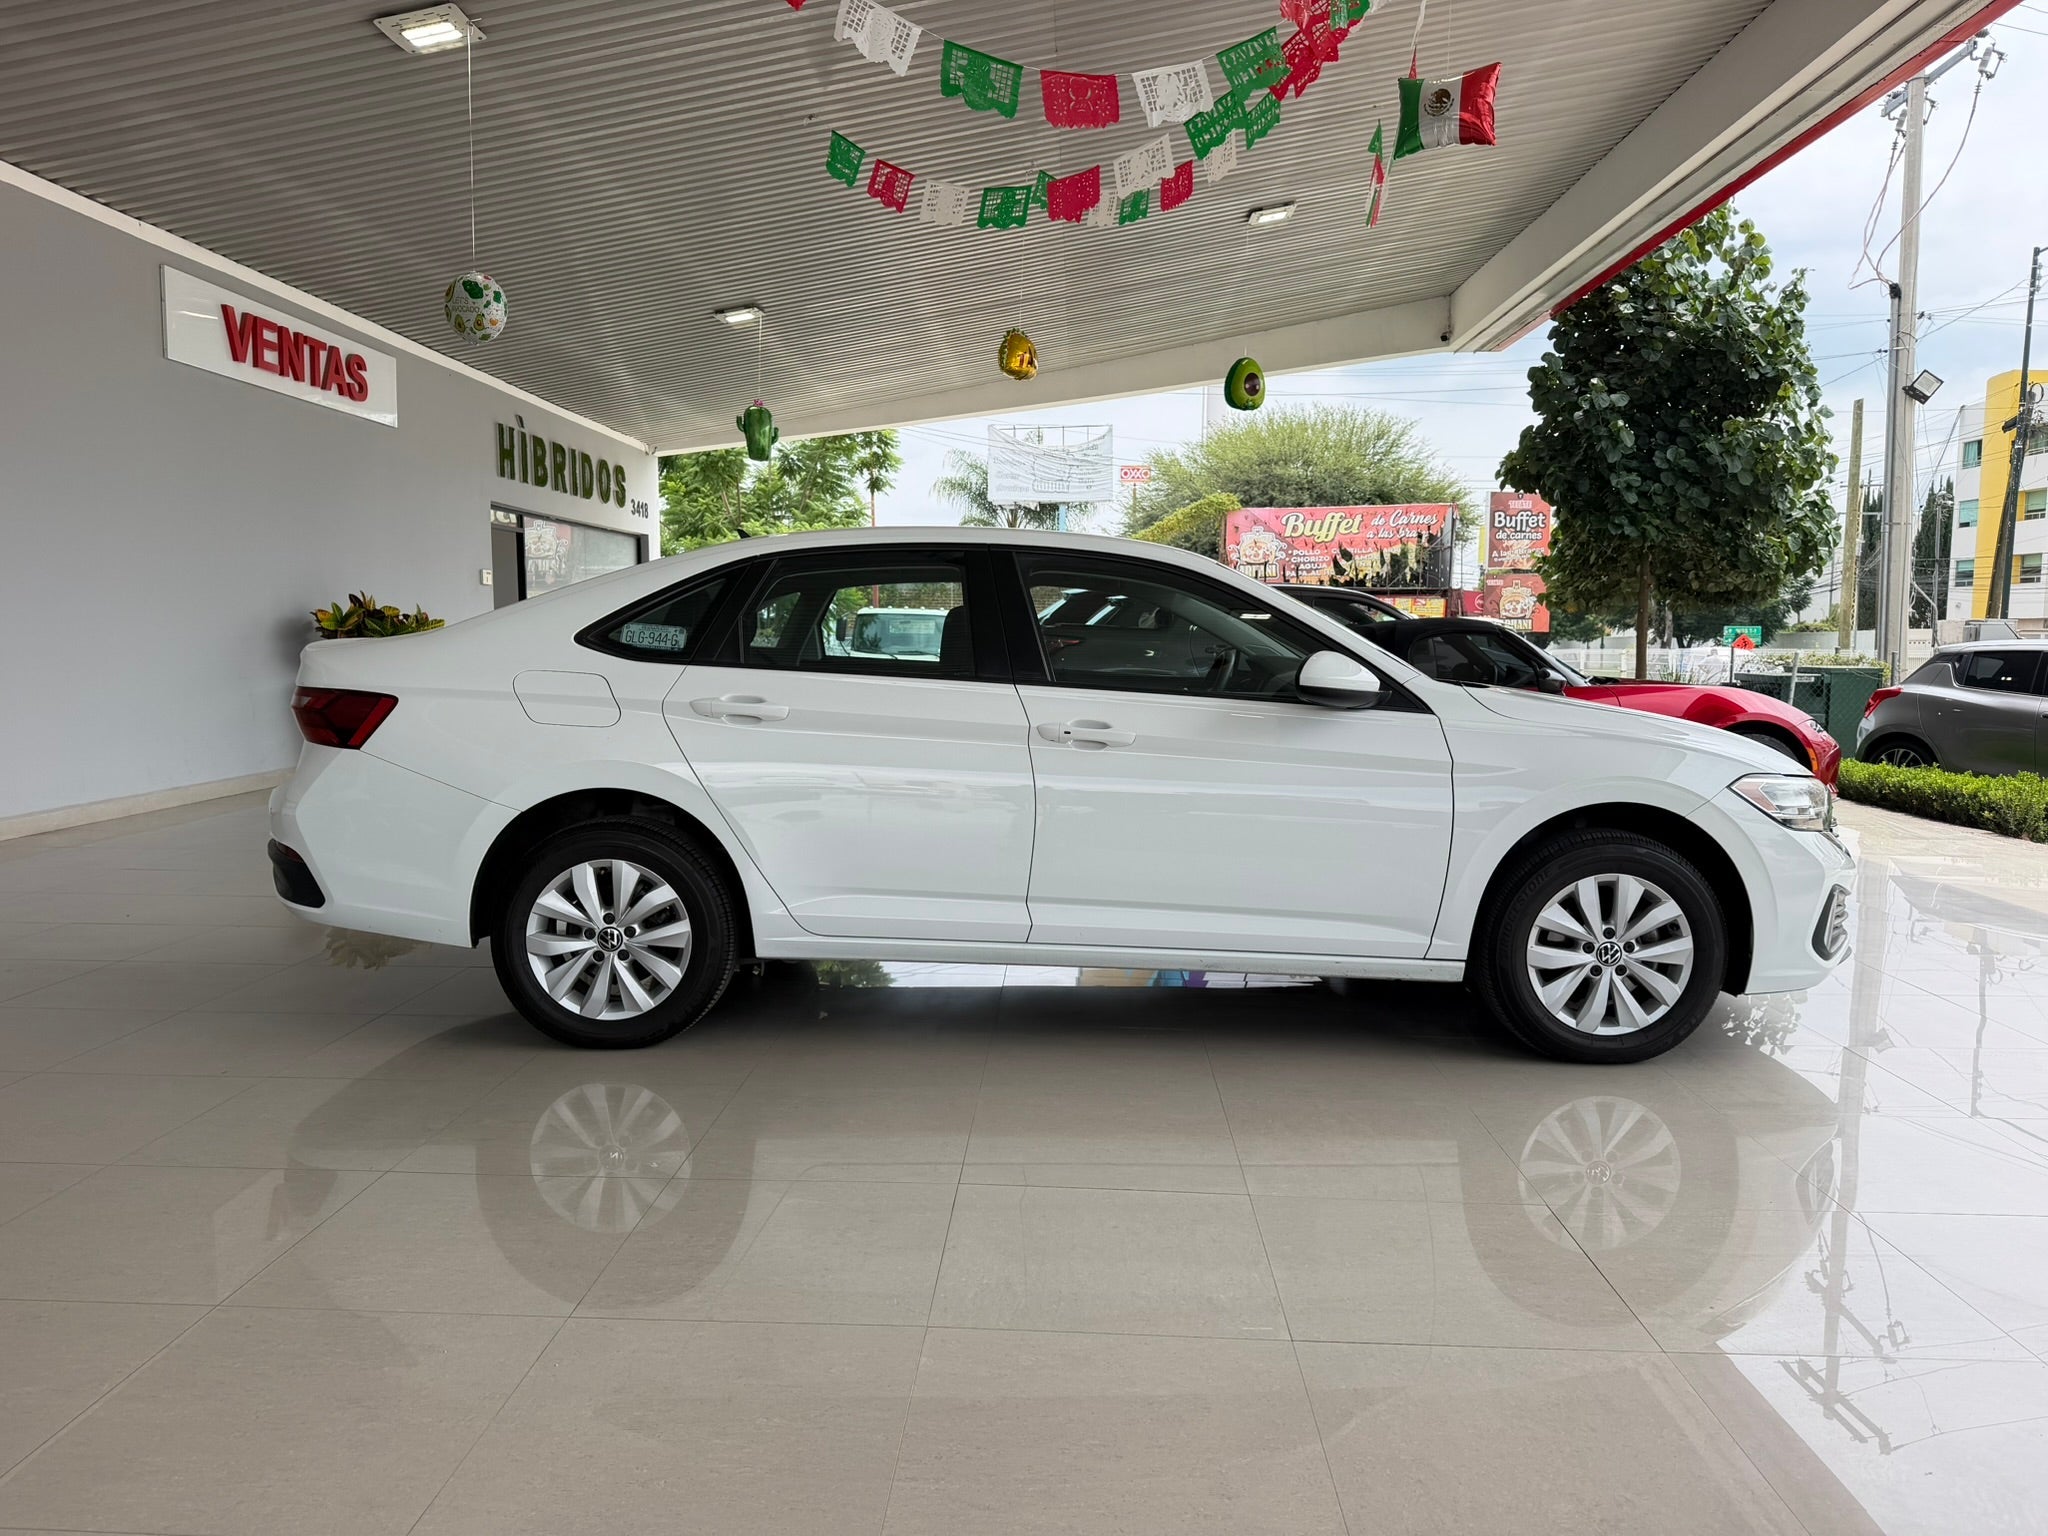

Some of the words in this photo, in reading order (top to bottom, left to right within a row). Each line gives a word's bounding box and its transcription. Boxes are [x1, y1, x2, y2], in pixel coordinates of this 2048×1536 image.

[221, 303, 368, 402] VENTAS
[1121, 468, 1150, 480] OXXO
[631, 499, 649, 519] 3418
[1370, 514, 1386, 526] de
[1389, 509, 1438, 527] Carnes
[1281, 511, 1363, 543] Buffet
[1494, 511, 1546, 531] Buffet
[1366, 530, 1375, 539] a
[1377, 527, 1394, 539] las
[1496, 529, 1507, 540] de
[1510, 532, 1542, 540] carnes
[1291, 555, 1330, 563] CHORIZO
